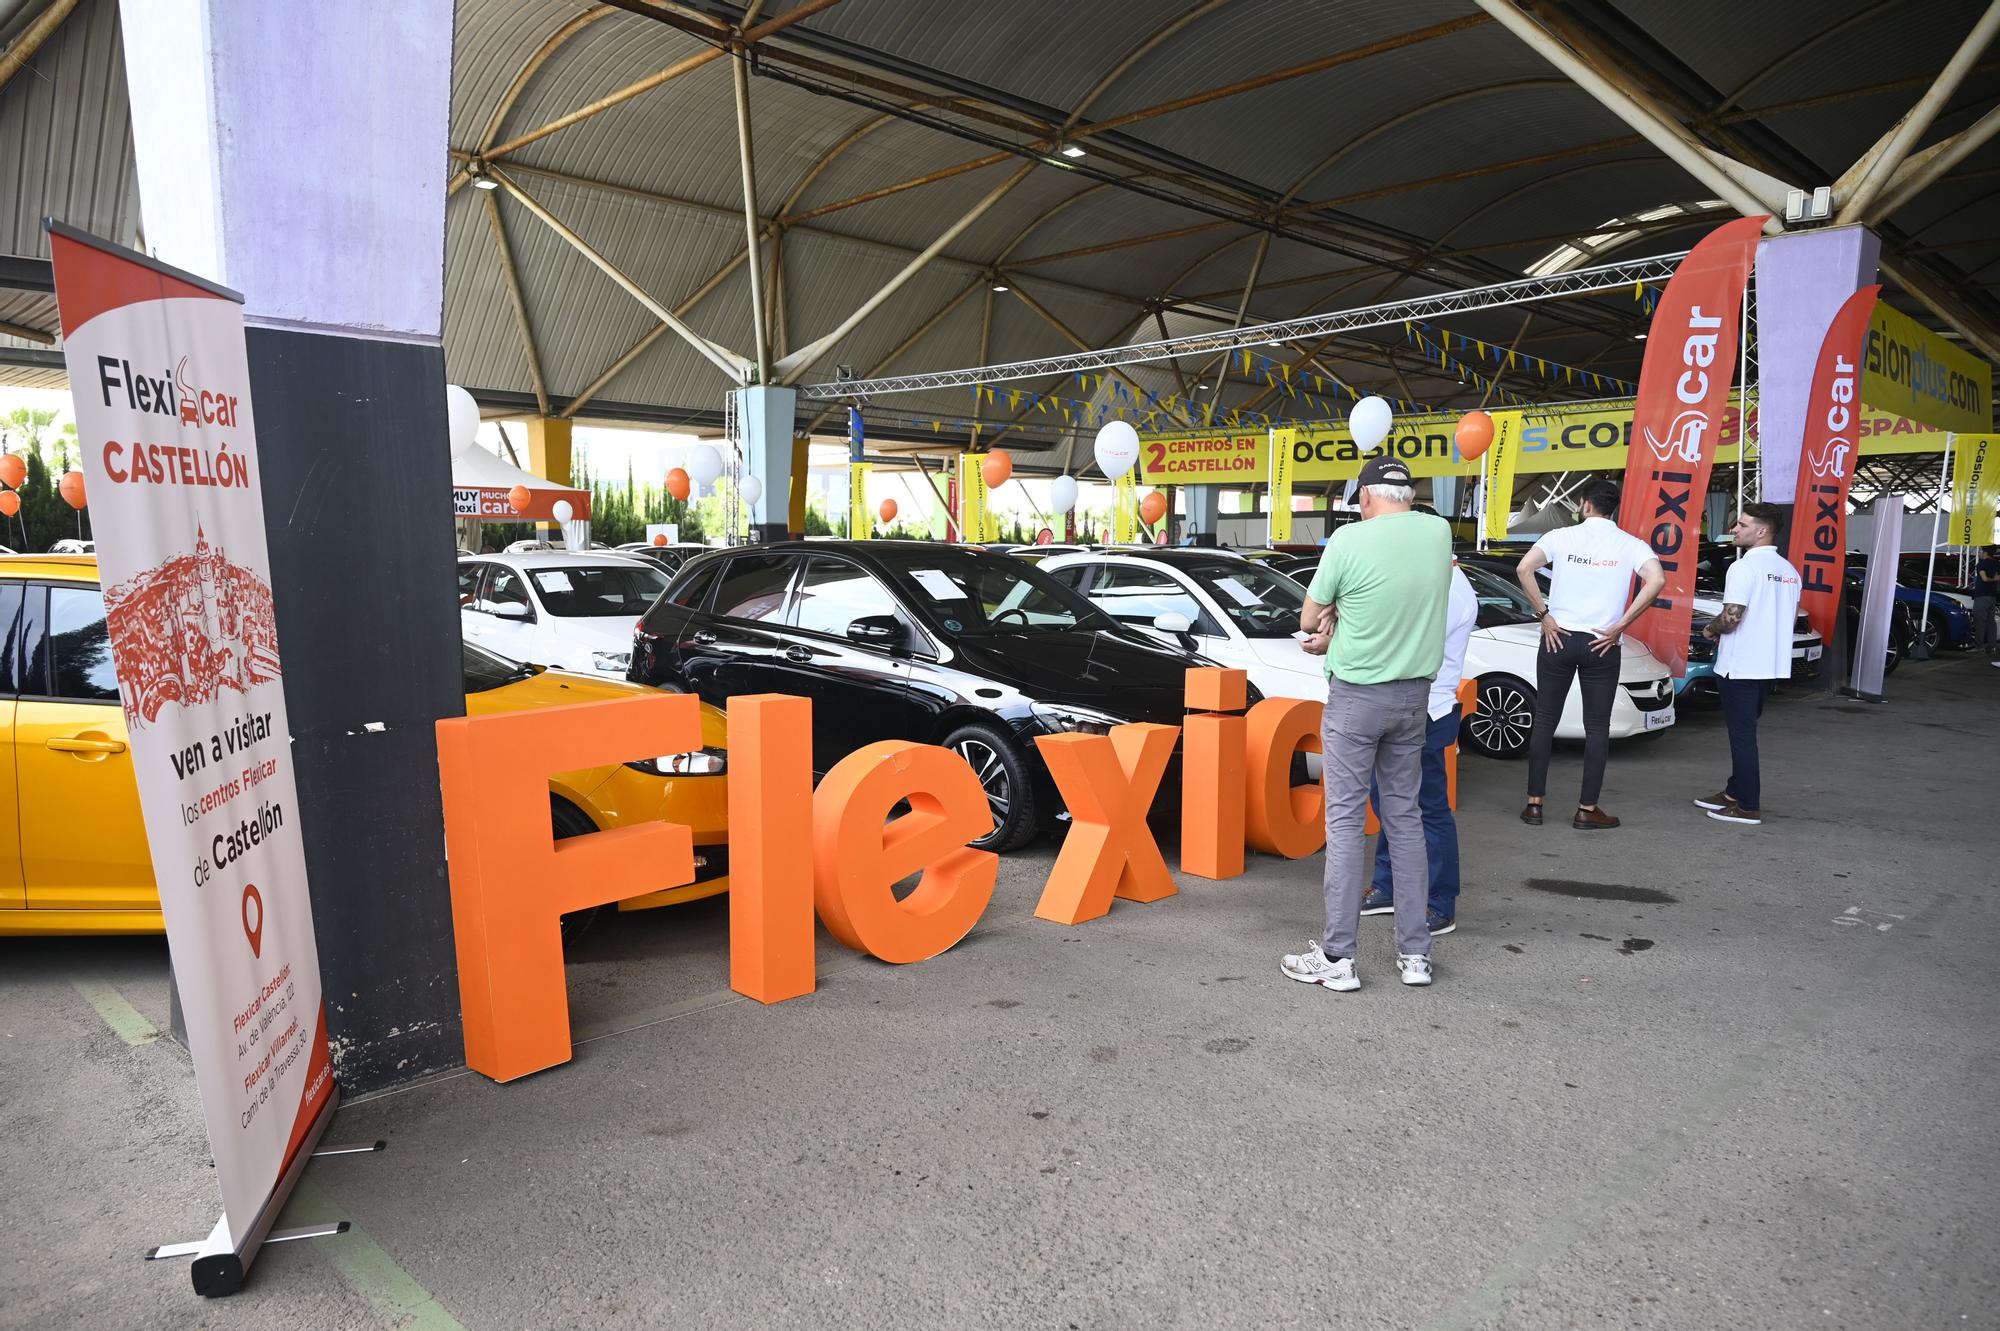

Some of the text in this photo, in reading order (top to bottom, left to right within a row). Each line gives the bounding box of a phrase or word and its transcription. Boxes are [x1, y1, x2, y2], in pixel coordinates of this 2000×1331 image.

[97, 355, 176, 417] Flexi
[103, 441, 249, 489] CASTELLÓN
[1147, 438, 1256, 474] 2 CENTROS EN
[1167, 455, 1256, 473] CASTELLÓN
[455, 502, 477, 513] lexi
[1802, 484, 1839, 593] Flexi
[1567, 554, 1592, 565] Flexi
[170, 712, 271, 781] ven a visitar
[181, 757, 277, 827] los centros Flexicar
[194, 800, 283, 888] de Castellón
[436, 666, 1478, 1083] Flexic
[233, 996, 261, 1034] Flexicar
[250, 1028, 259, 1047] de
[244, 1055, 271, 1094] Flexicar
[259, 1087, 269, 1105] de
